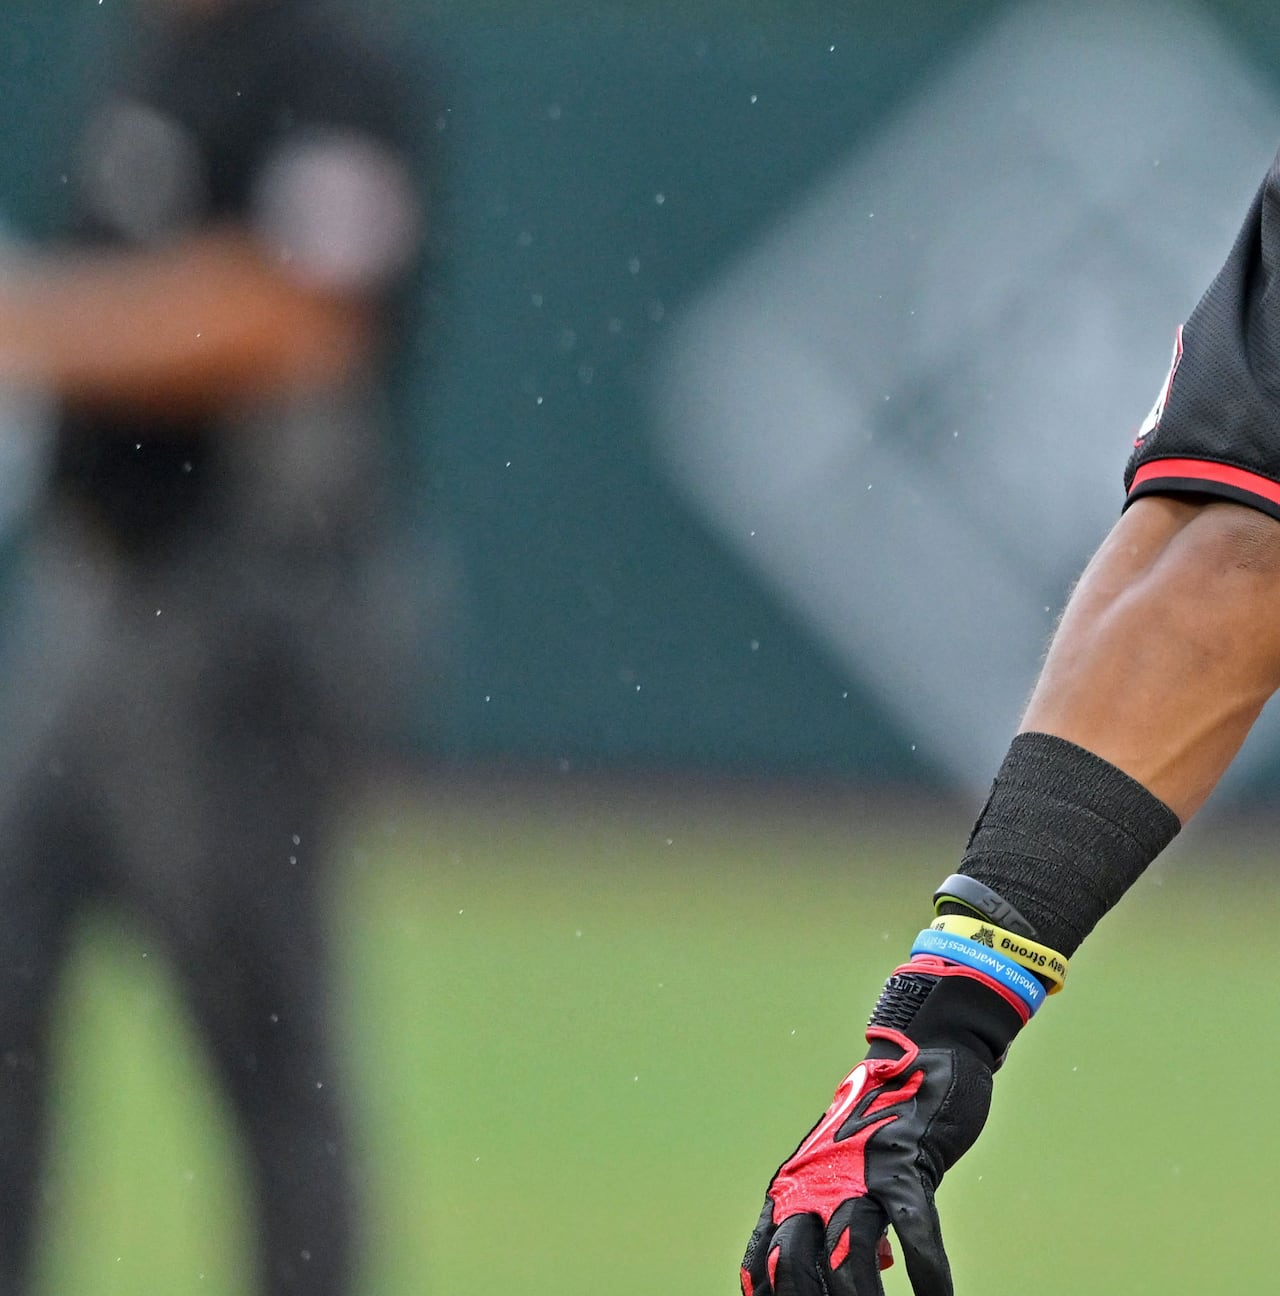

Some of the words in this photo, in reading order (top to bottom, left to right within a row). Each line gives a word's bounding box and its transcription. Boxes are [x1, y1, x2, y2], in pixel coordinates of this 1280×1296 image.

[948, 940, 1006, 973] Awareness
[1000, 937, 1047, 967] Strong
[1005, 966, 1040, 1000] Myositis
